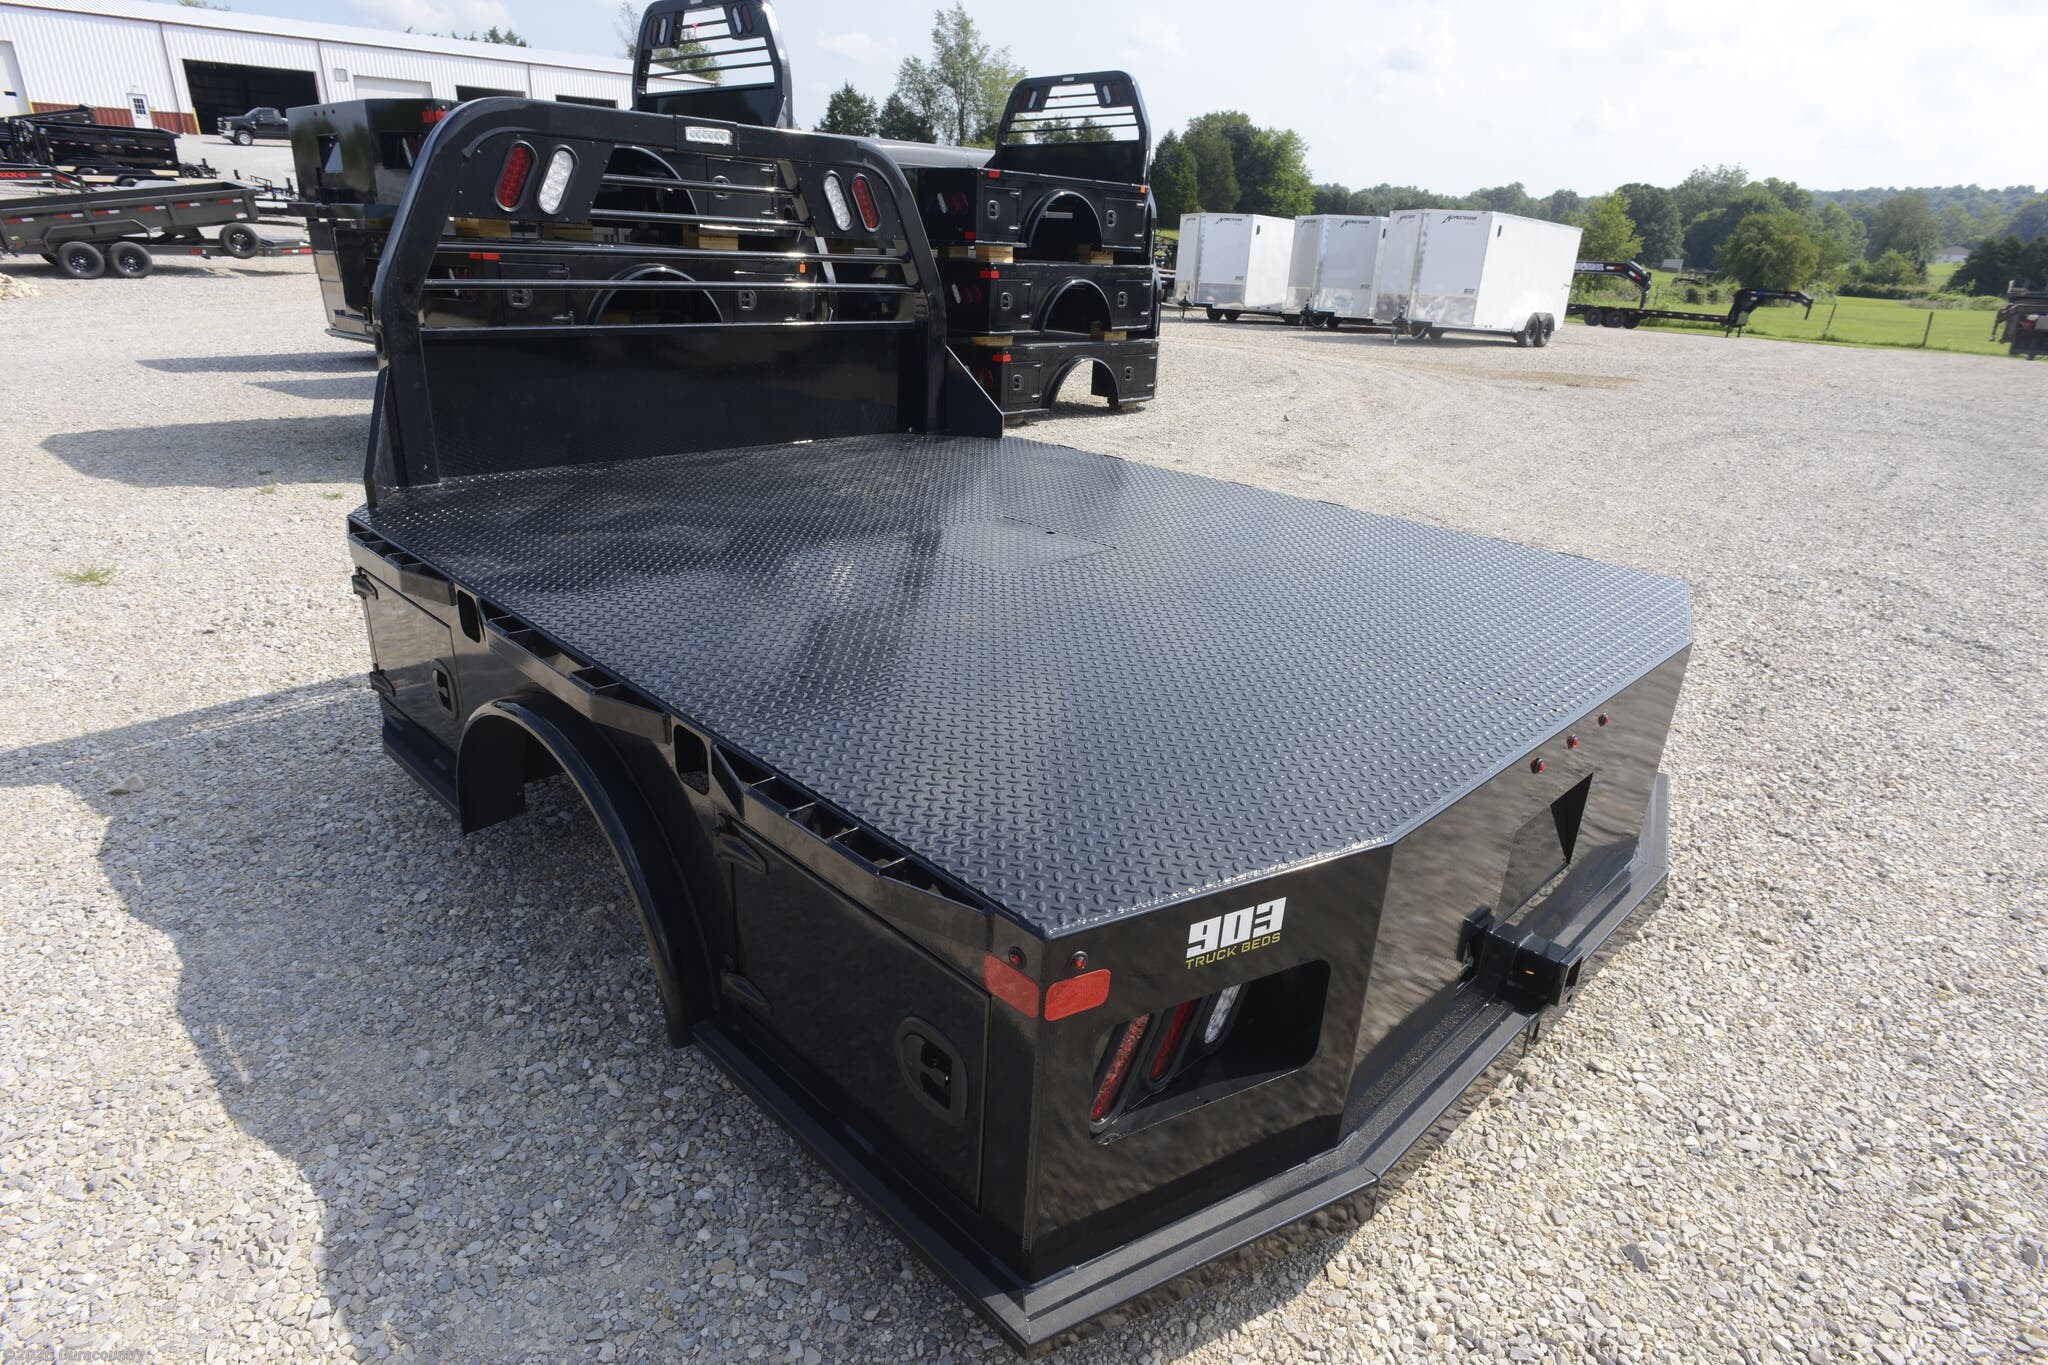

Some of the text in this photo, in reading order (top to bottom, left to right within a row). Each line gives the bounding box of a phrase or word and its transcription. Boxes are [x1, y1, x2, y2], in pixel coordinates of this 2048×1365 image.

[1186, 897, 1287, 958] 903
[1186, 933, 1280, 970] TRUCK BEDS
